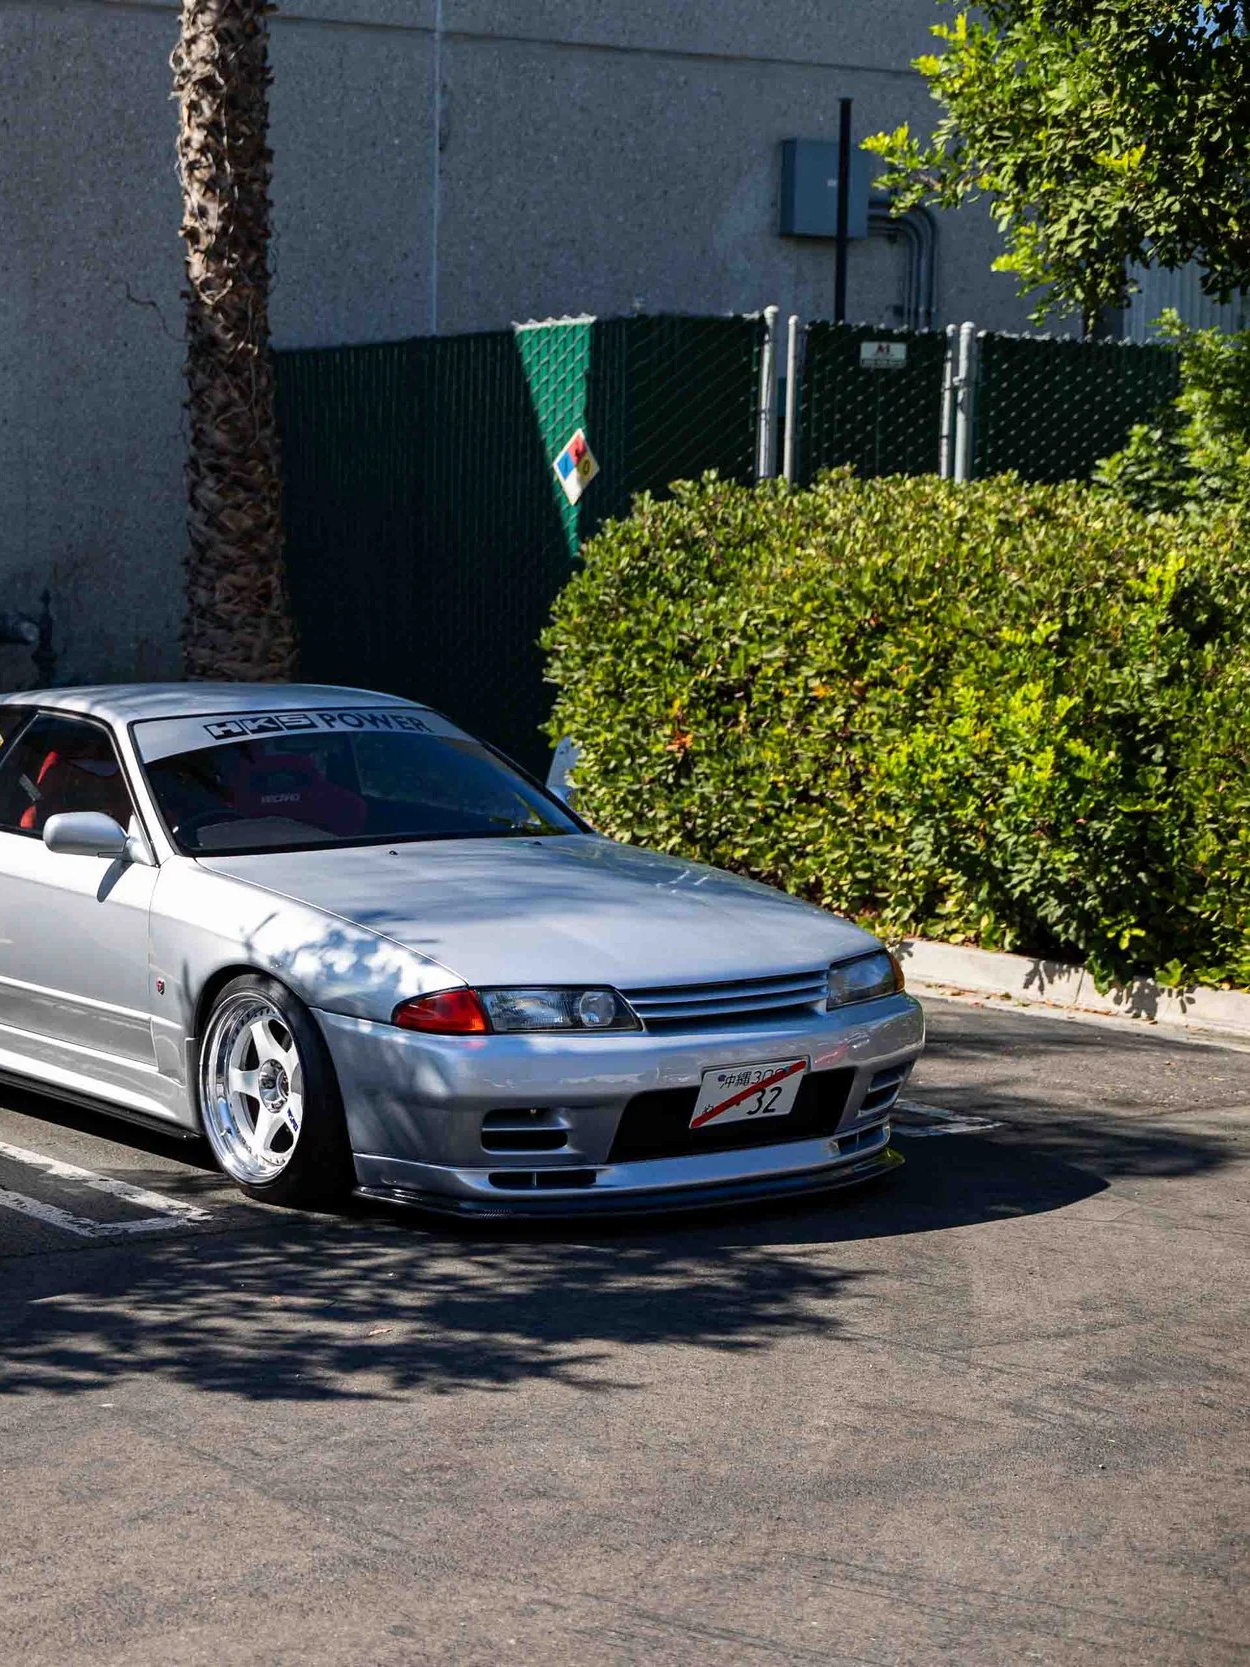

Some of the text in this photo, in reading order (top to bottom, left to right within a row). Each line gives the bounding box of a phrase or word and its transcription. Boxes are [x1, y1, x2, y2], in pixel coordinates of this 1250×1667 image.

[203, 713, 434, 740] HKS POWER
[719, 1071, 751, 1089] 沖縄
[746, 1086, 782, 1115] 32
